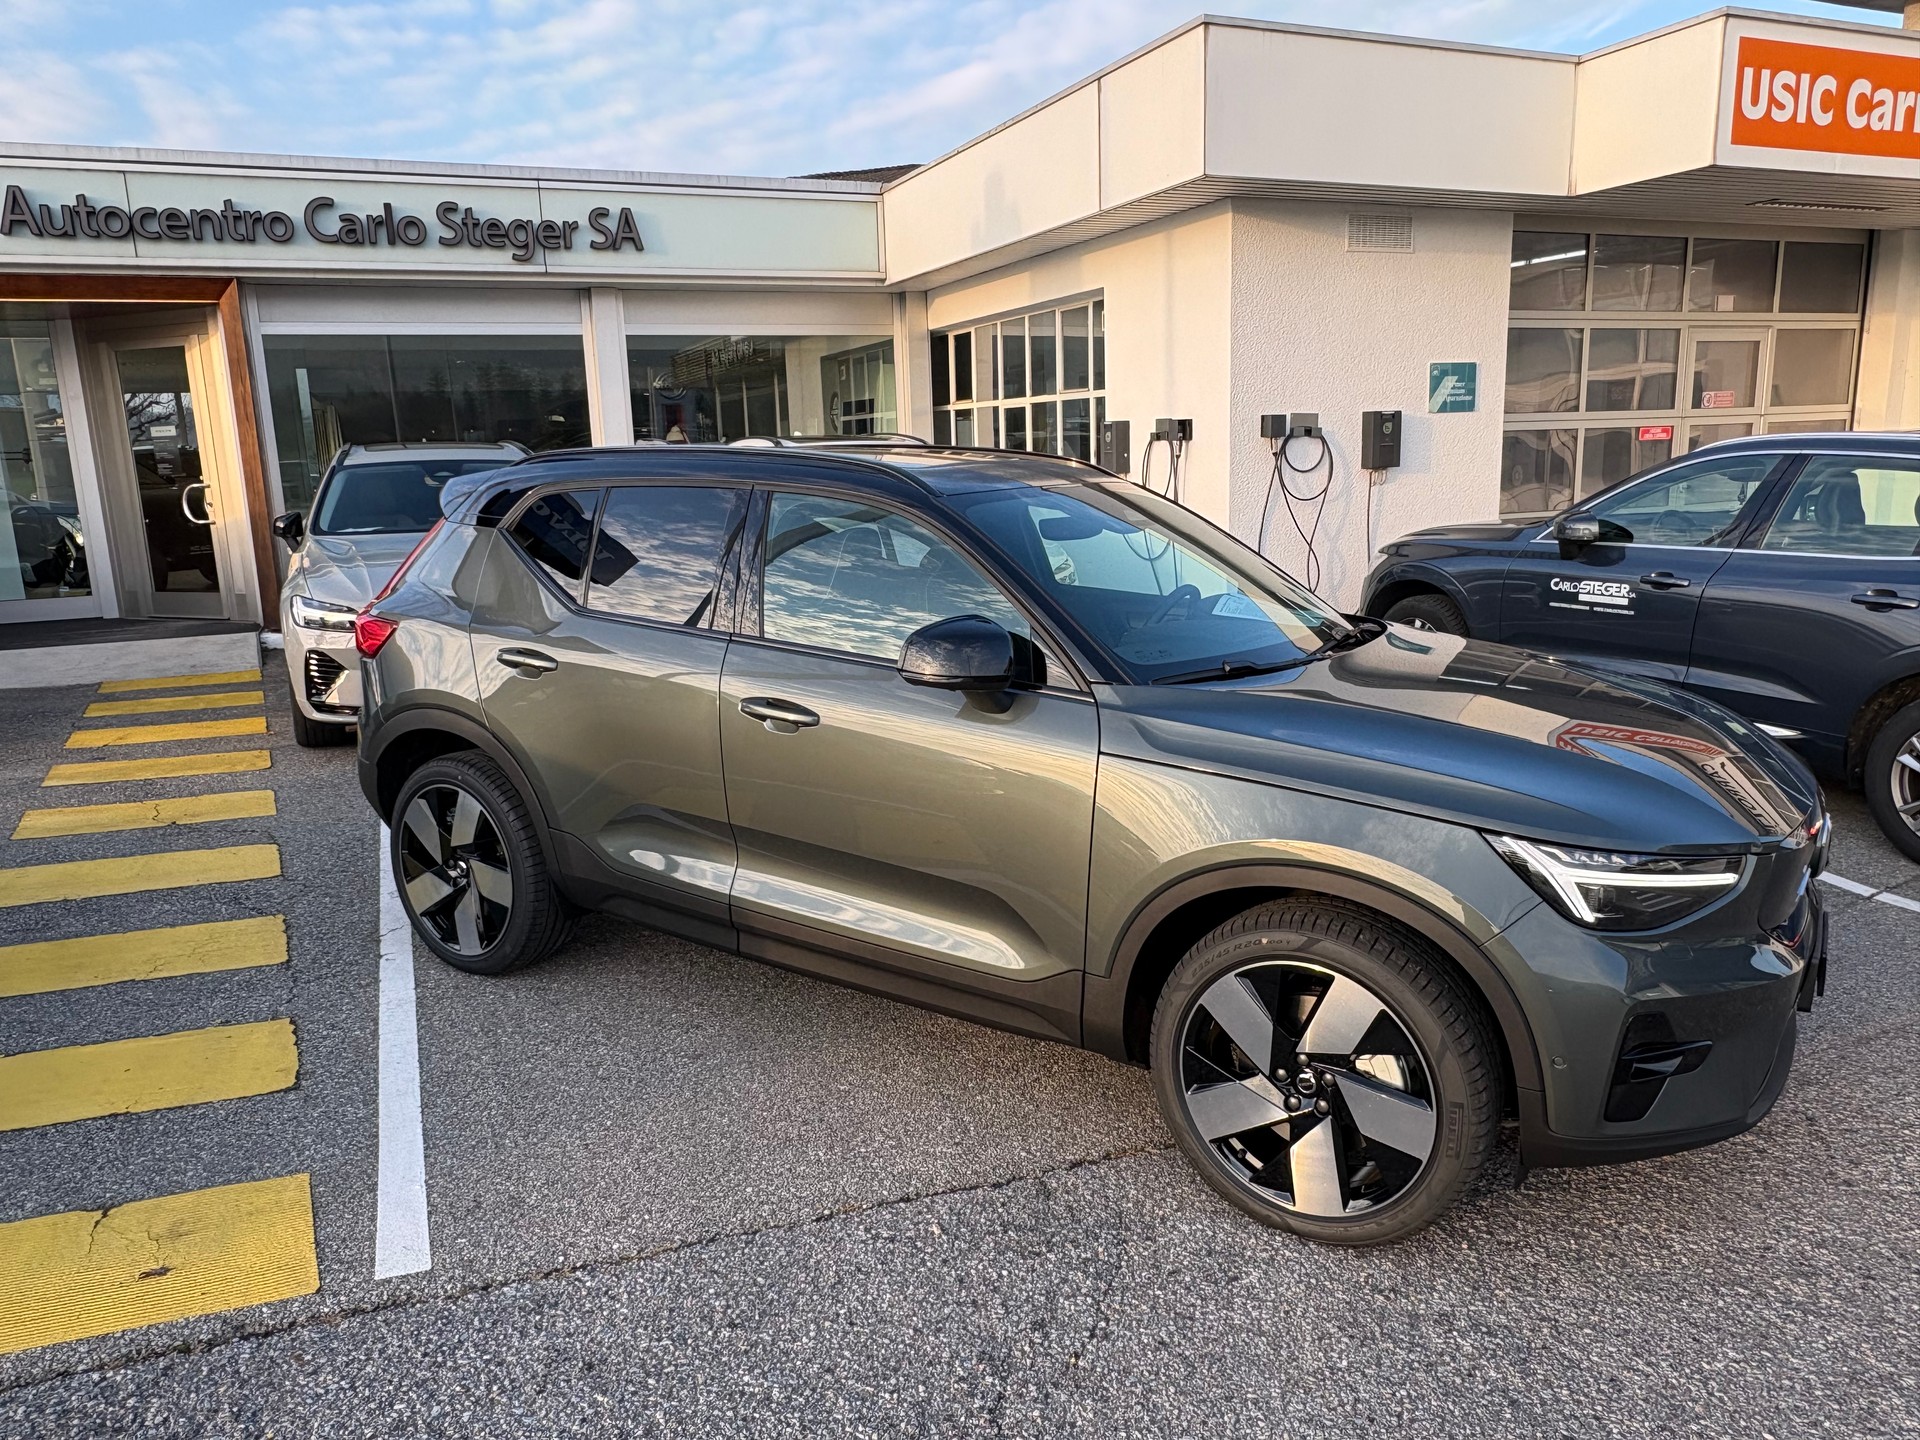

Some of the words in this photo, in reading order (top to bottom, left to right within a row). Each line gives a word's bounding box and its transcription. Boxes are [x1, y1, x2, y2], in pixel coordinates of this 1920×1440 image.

[1741, 66, 1837, 127] USIC
[1, 185, 295, 244] Autocentro
[304, 196, 428, 246] Carlo
[437, 201, 578, 262] Steger
[588, 206, 645, 252] SA
